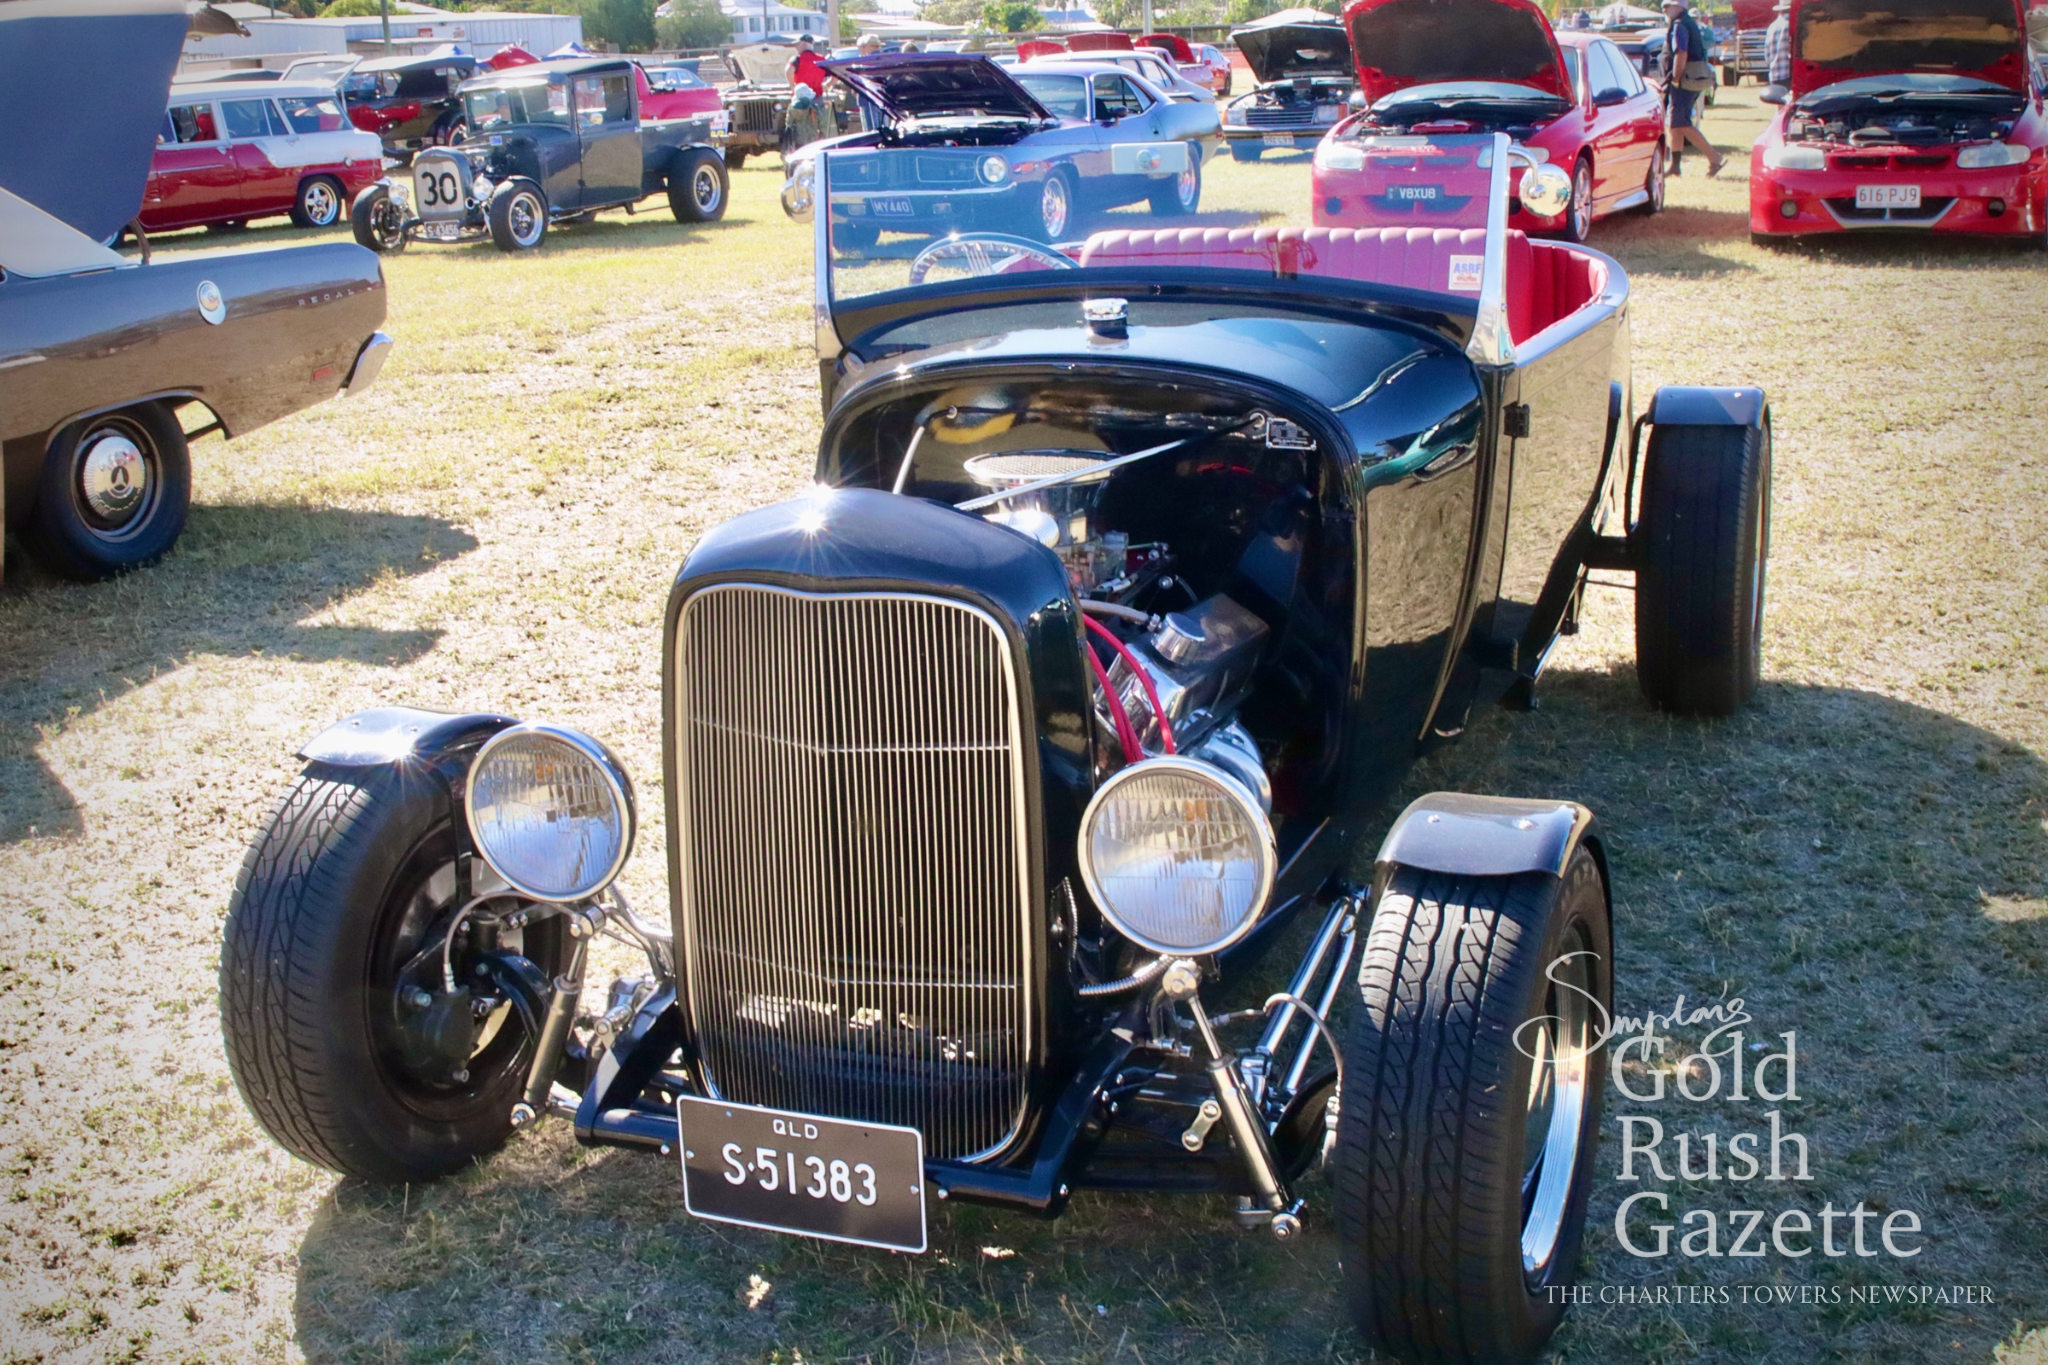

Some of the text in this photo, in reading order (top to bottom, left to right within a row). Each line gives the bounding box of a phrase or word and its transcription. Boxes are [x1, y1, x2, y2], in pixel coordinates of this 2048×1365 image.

[421, 171, 457, 206] 30
[1398, 187, 1436, 199] V8XU8
[873, 201, 910, 213] MY440
[1454, 263, 1482, 274] ASRF
[772, 1118, 819, 1140] QLD
